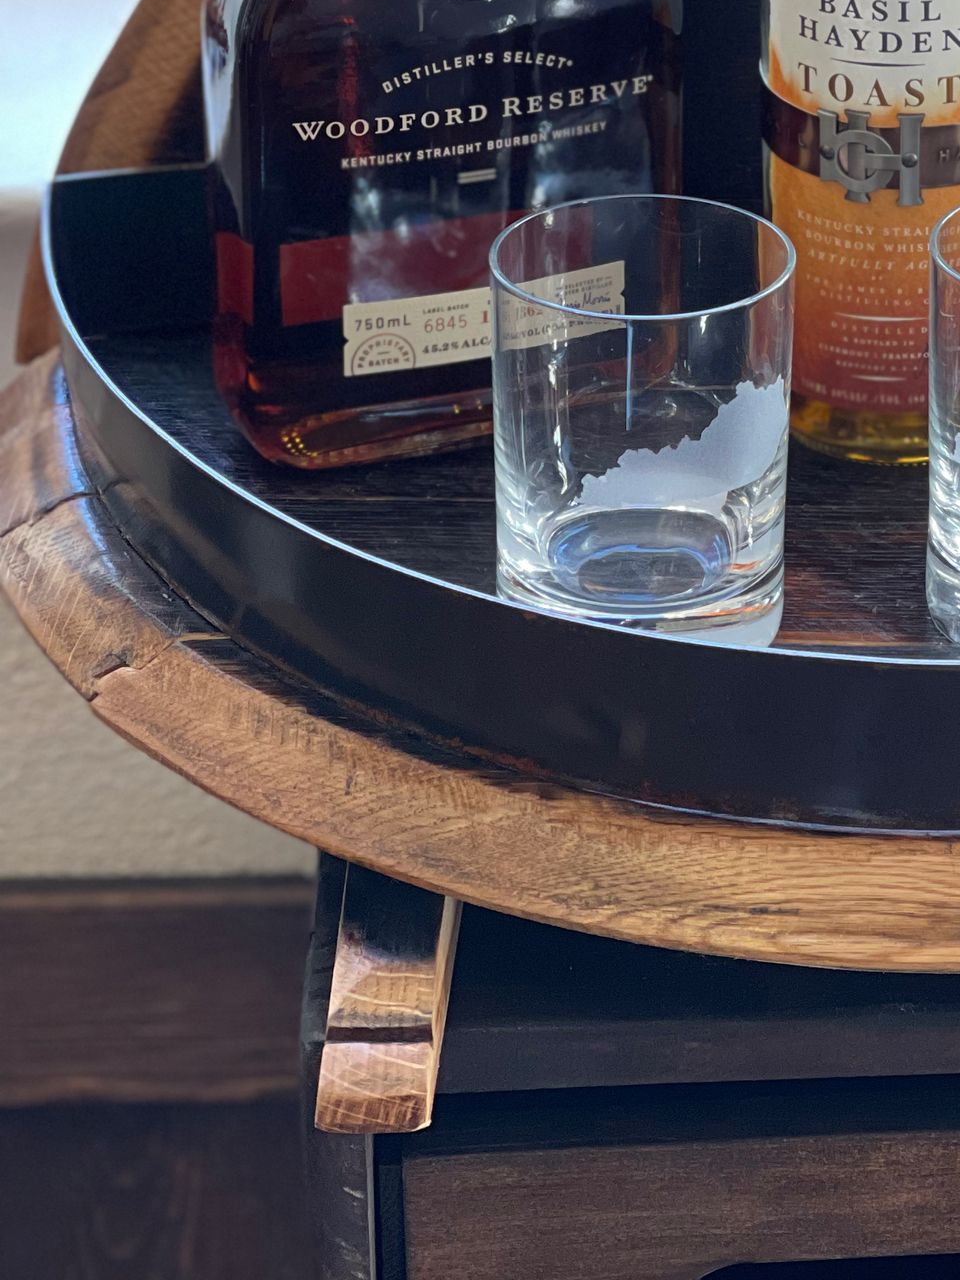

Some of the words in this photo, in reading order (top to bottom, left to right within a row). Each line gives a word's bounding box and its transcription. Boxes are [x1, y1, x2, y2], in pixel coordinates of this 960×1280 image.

[382, 52, 495, 94] DISTILLER'S
[502, 51, 567, 70] SELECT
[292, 104, 489, 142] WOODFORD
[502, 75, 651, 119] RESERVE
[341, 151, 412, 170] KENTUCKY
[417, 142, 483, 161] STRAIGHT
[487, 133, 548, 151] BOURBON
[552, 122, 608, 140] WHISKEY
[797, 209, 875, 236] KENTUCKY
[806, 229, 876, 251] BOURBON
[807, 248, 897, 270] ARTFULLY
[355, 314, 412, 332] 750mL
[422, 308, 445, 316] LABEL
[424, 314, 468, 333] 6845
[357, 339, 411, 368] PROPRIETARY
[422, 341, 459, 354] 45.2%
[368, 357, 400, 368] BATCH
